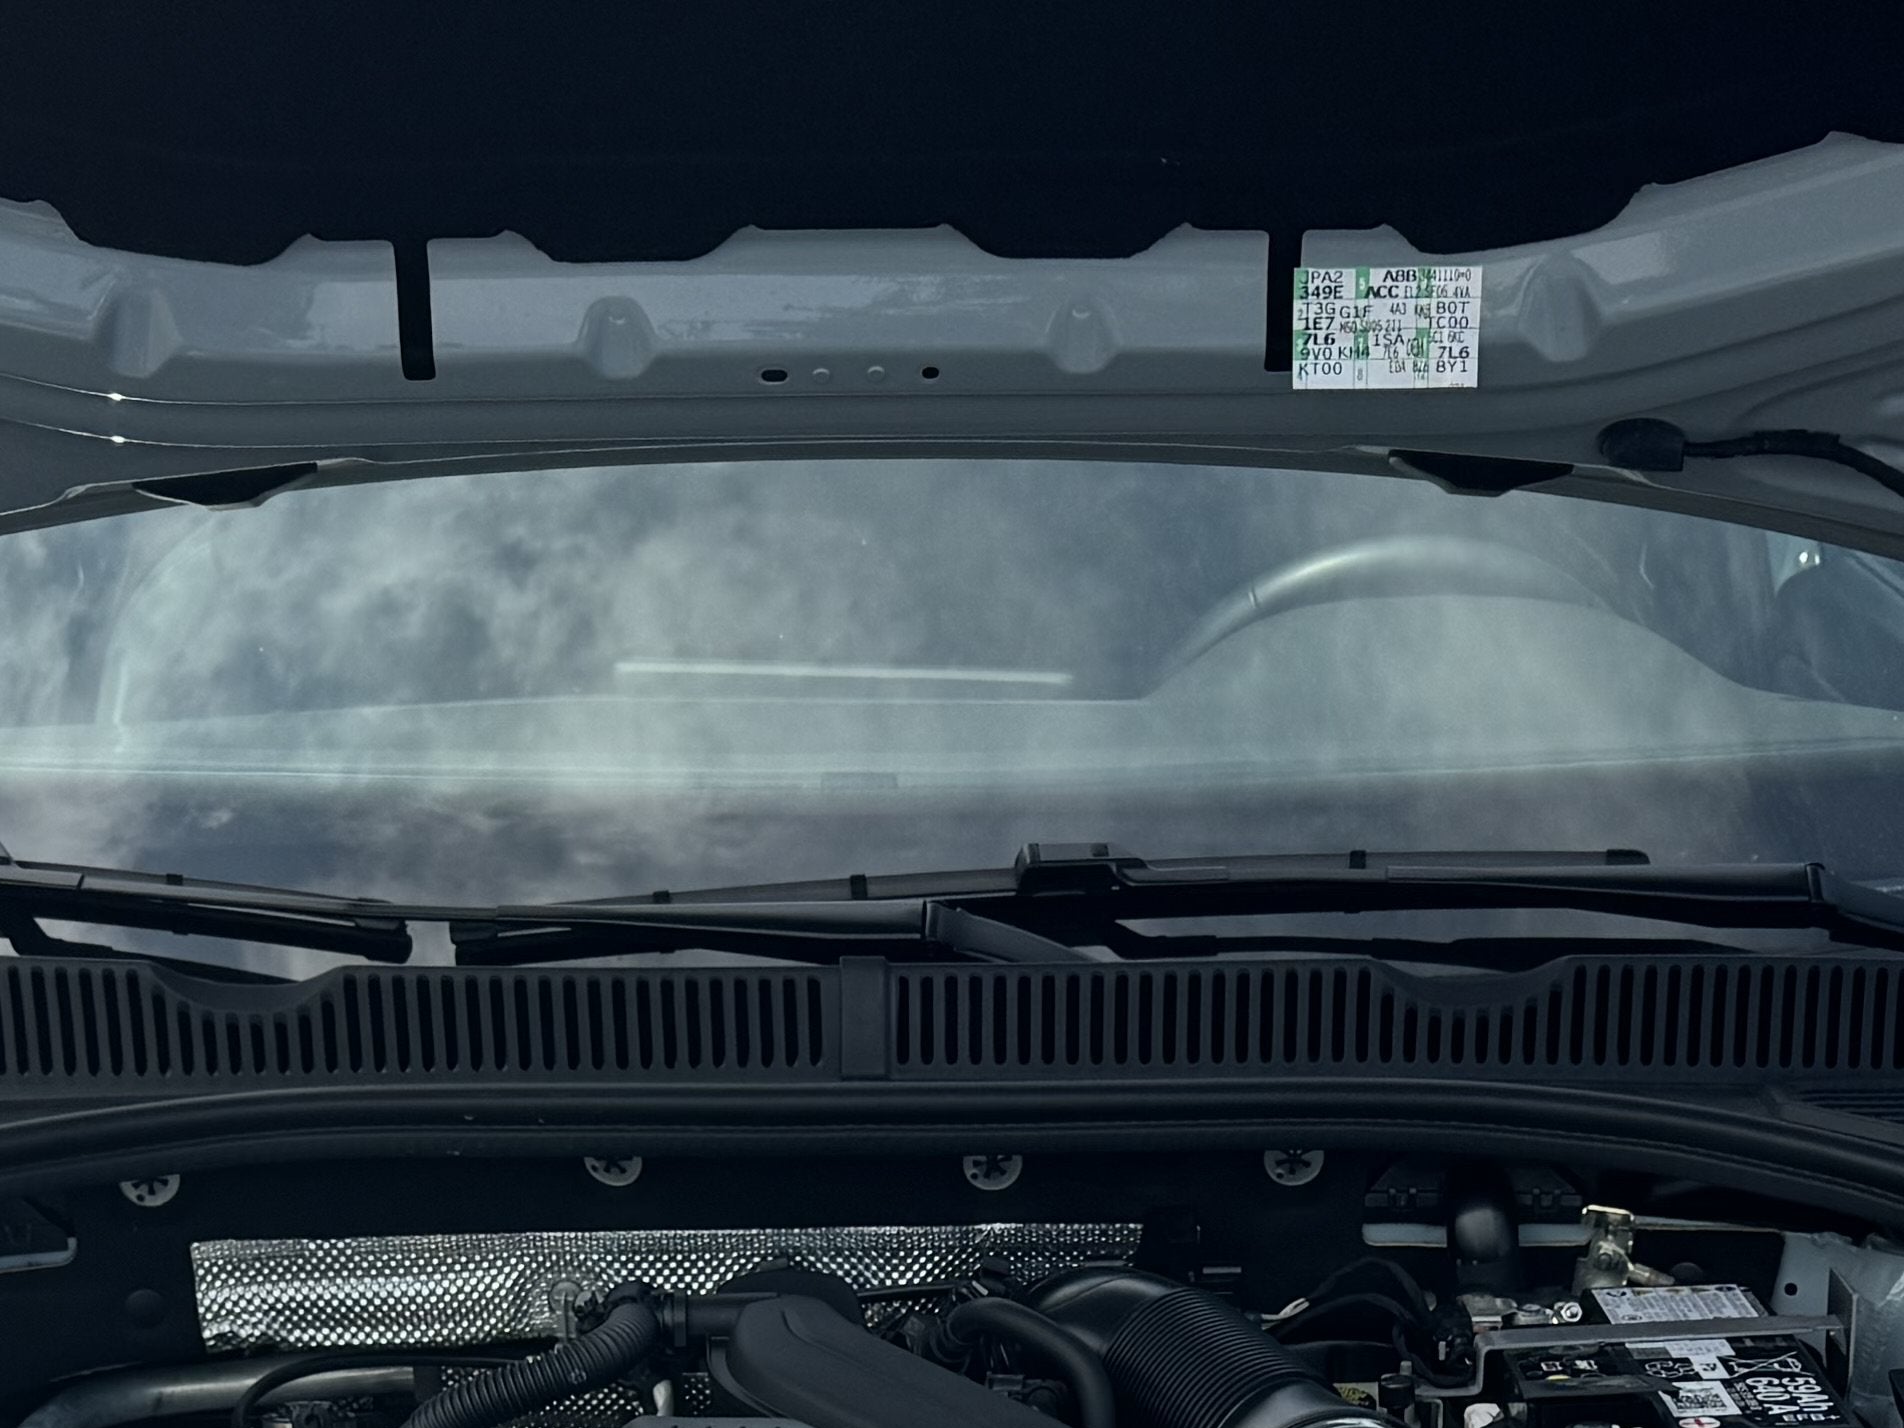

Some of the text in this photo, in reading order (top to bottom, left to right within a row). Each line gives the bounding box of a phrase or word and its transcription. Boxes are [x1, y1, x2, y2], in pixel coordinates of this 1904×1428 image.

[1300, 285, 1344, 299] 349E
[1302, 302, 1336, 315] T3G
[1302, 332, 1336, 345] 7L6
[1438, 346, 1469, 359] 7L6
[1745, 1377, 1790, 1401] 640
[1782, 1377, 1834, 1412] 59Ah
[1763, 1403, 1800, 1415] A
